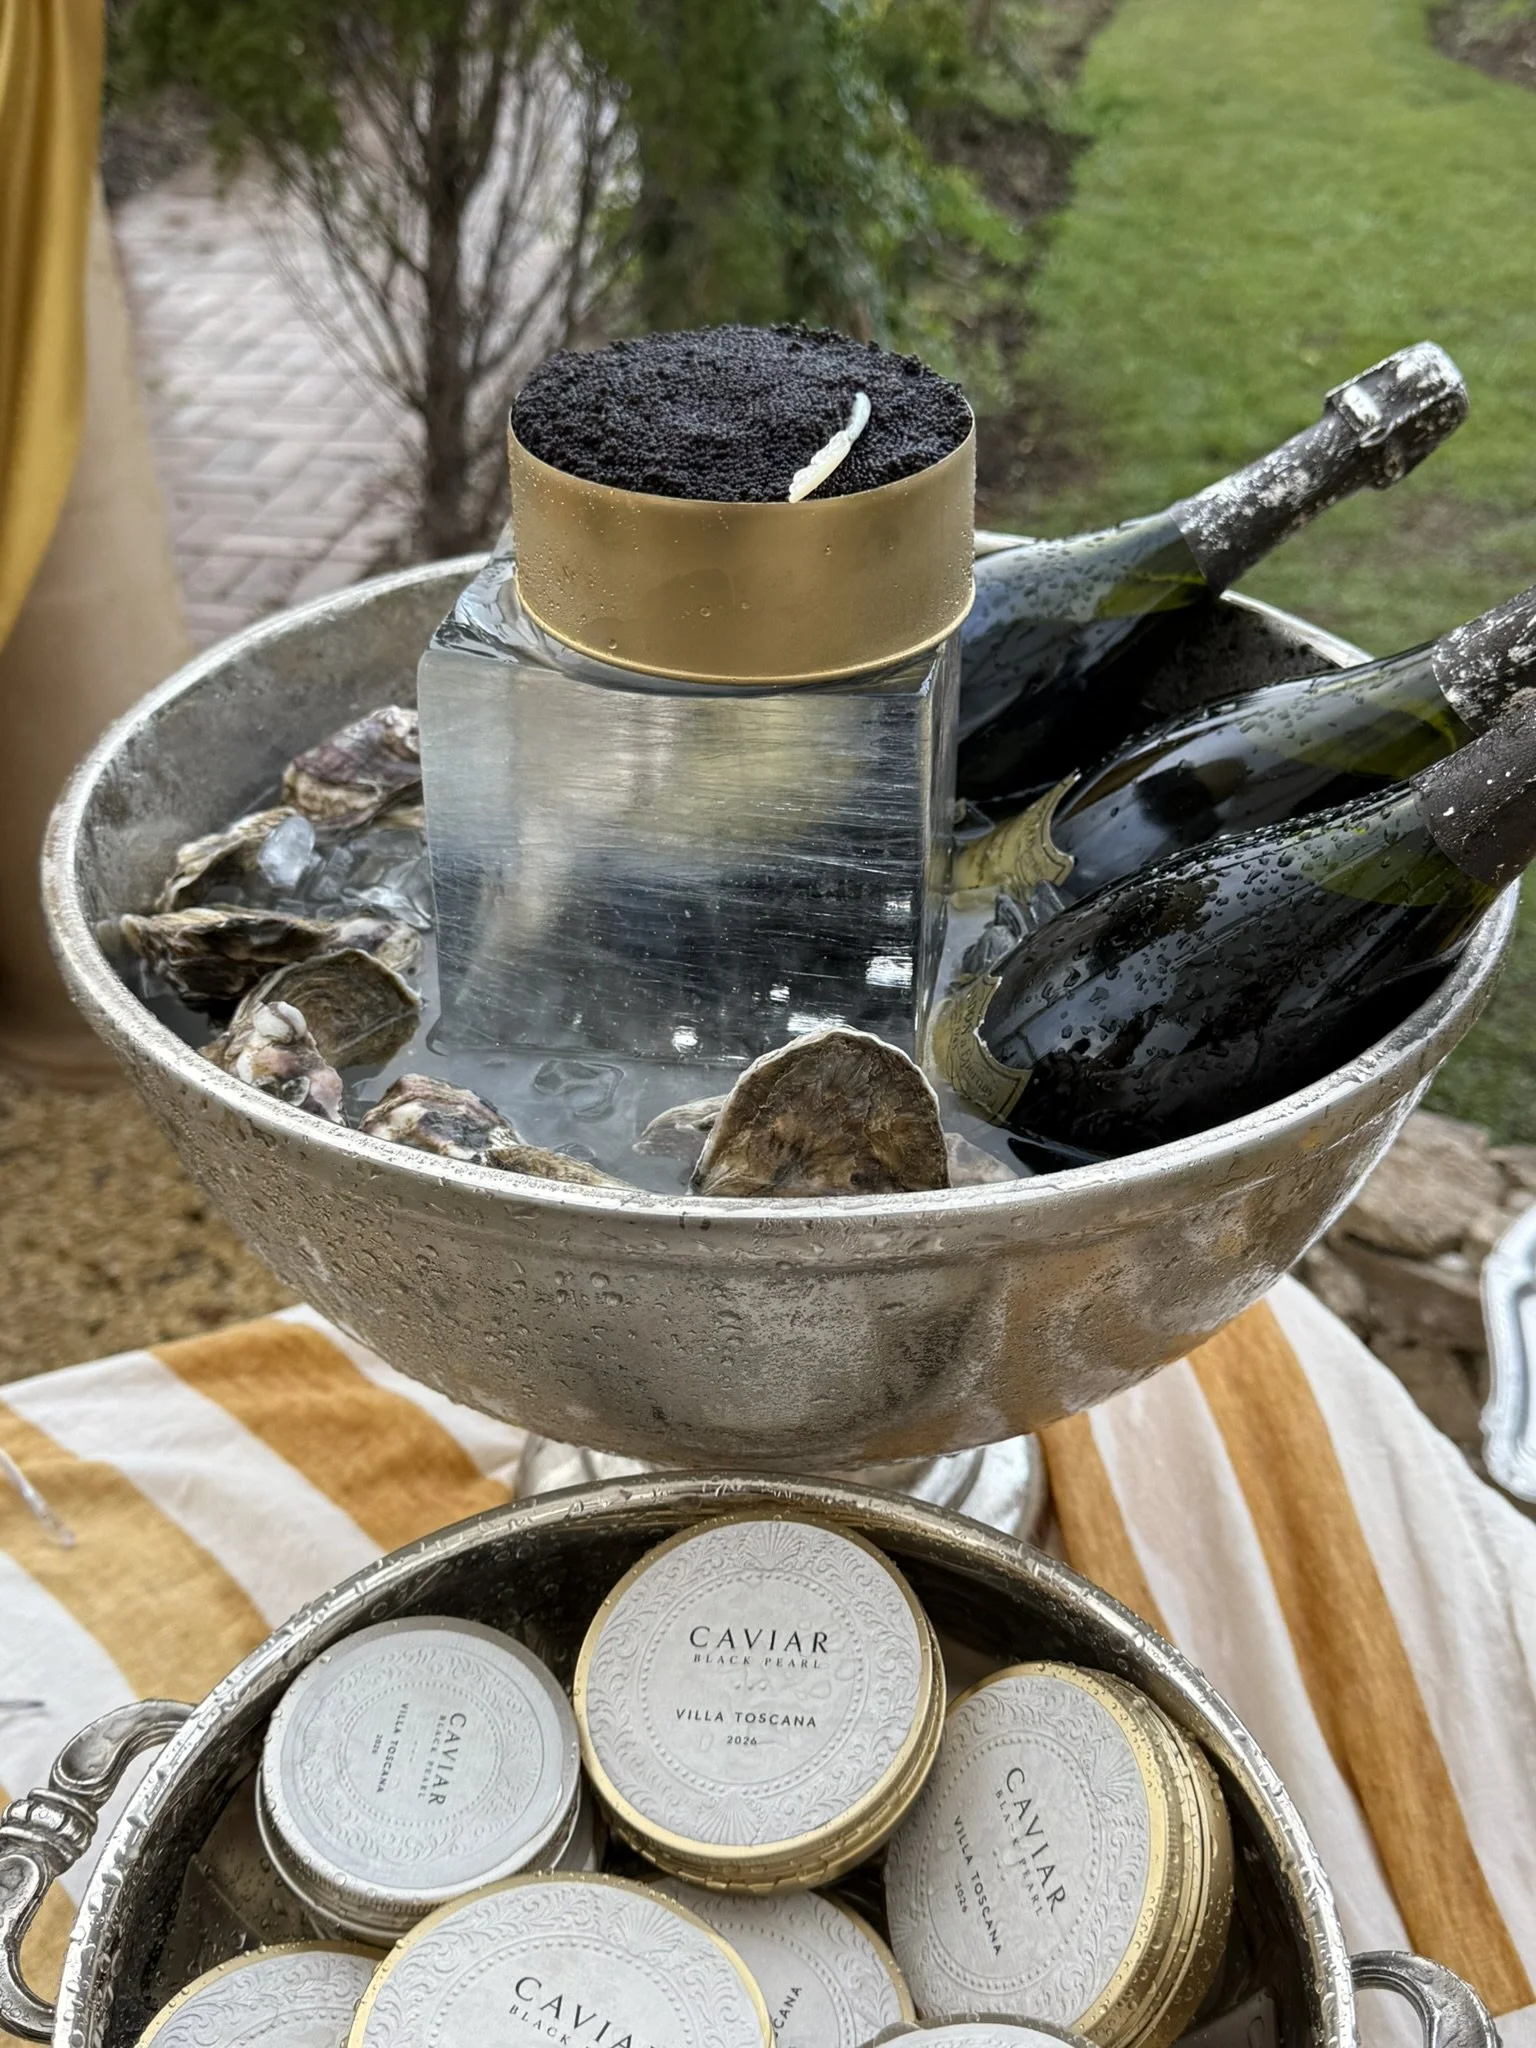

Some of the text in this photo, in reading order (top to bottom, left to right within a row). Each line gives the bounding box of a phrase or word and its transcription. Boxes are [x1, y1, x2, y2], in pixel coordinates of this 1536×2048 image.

[689, 1625, 829, 1654] CAVIAR
[693, 1653, 822, 1670] BLACK PEARL
[376, 1702, 410, 1794] VILLA TOSCANA
[676, 1708, 817, 1728] VILLA TOSCANA
[726, 1734, 758, 1746] 2026
[418, 1714, 447, 1799] BLACK PEARL
[428, 1712, 467, 1806] CAVIAR
[1006, 1766, 1067, 1913] CAVIAR
[953, 1815, 1002, 1957] VILLA TOSCANA
[1017, 1857, 1044, 1918] PEARL
[508, 2004, 572, 2046] BLACK
[514, 1976, 655, 2048] CAVIA
[773, 1985, 803, 2039] CANA
